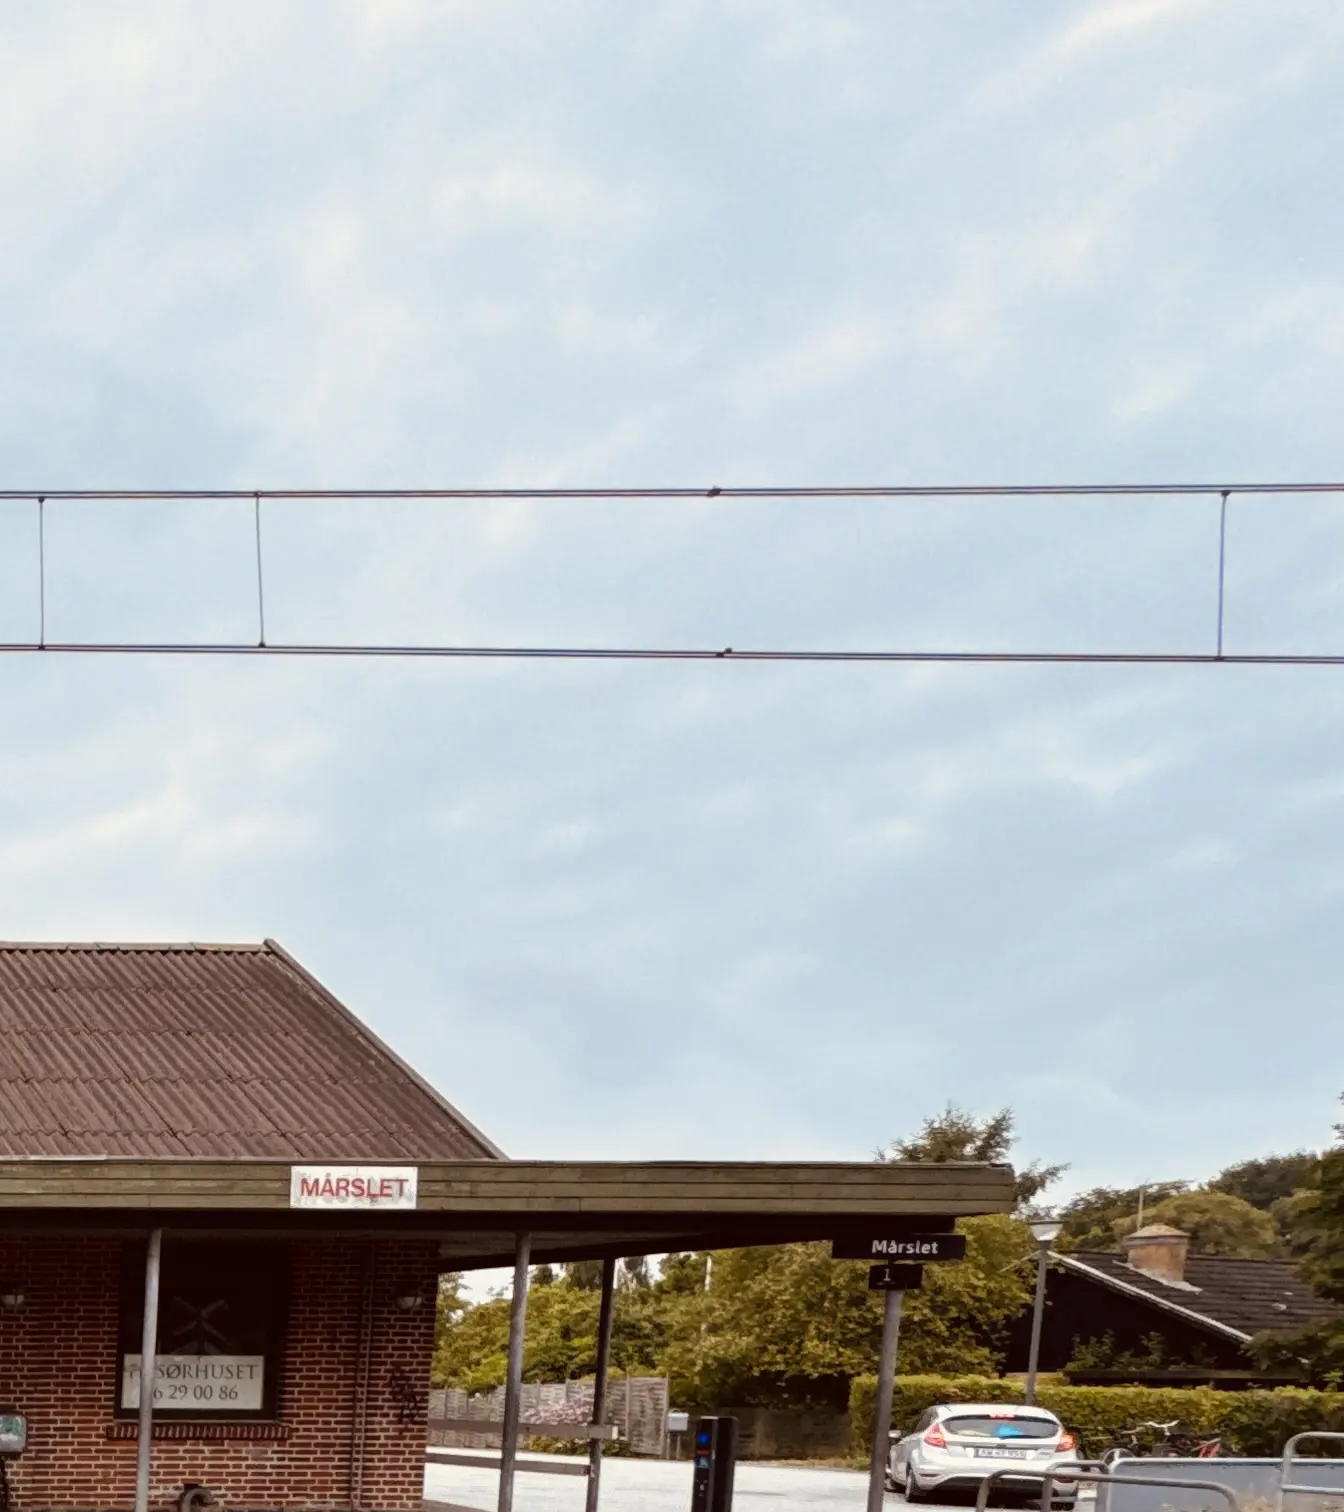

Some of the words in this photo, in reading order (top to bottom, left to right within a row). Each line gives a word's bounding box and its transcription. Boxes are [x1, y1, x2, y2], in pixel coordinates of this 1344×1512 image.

[300, 1172, 409, 1198] MÅRSLET
[872, 1239, 939, 1254] Mårslet
[883, 1267, 891, 1282] 1
[167, 1384, 188, 1400] 29
[193, 1384, 213, 1400] 00
[218, 1385, 238, 1401] 86
